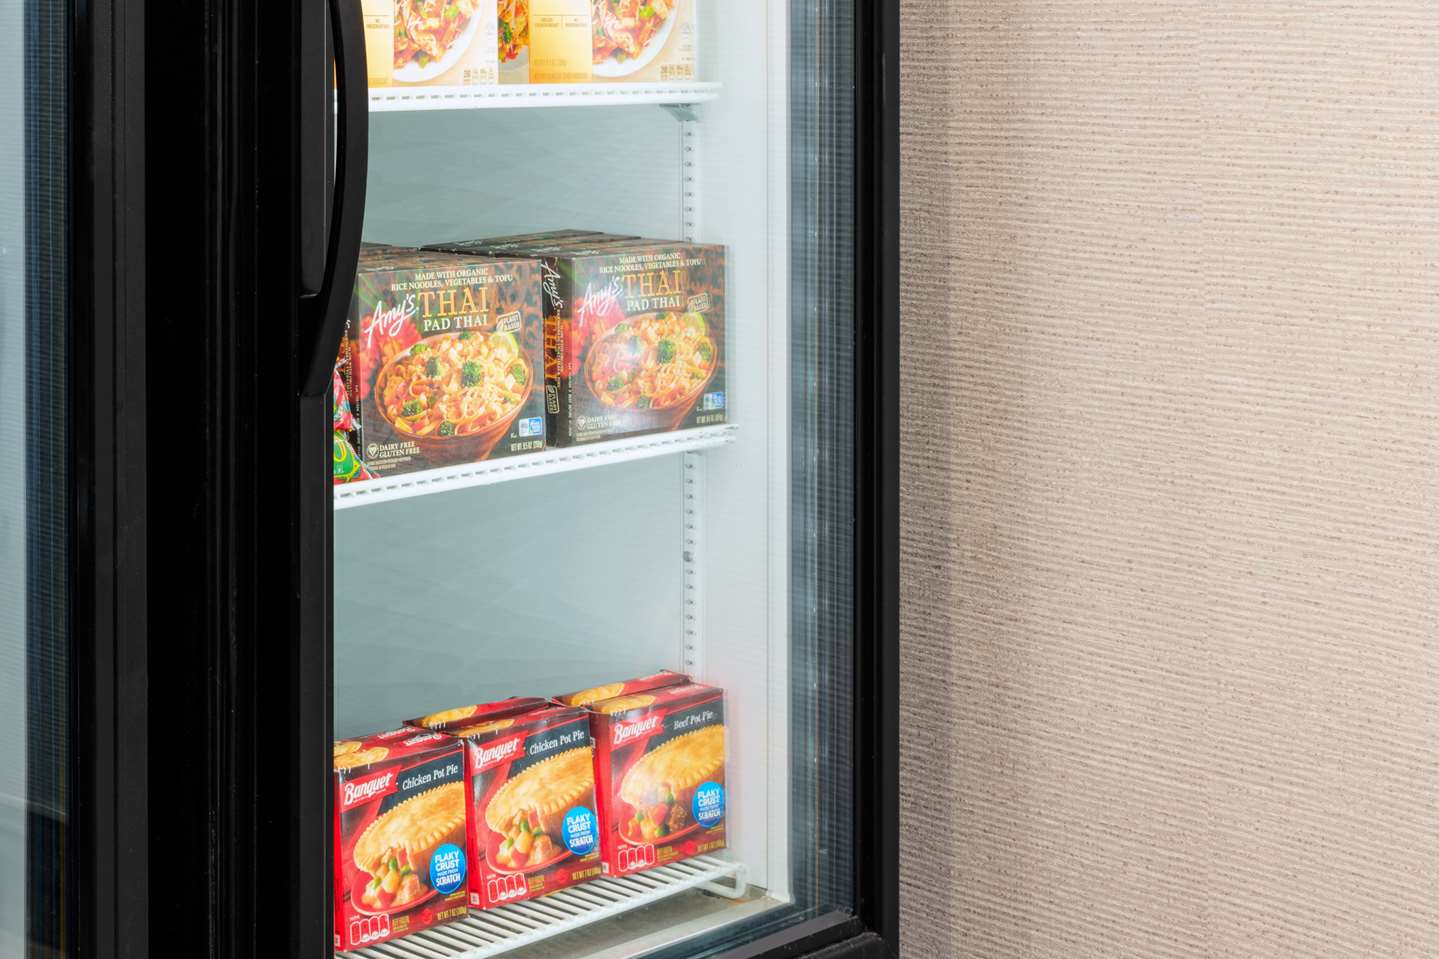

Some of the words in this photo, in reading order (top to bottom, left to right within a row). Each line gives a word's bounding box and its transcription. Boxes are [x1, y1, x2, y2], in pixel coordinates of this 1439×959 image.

[618, 255, 637, 265] MADE
[637, 254, 655, 263] WITH
[655, 251, 681, 262] ORGANIC
[414, 271, 436, 281] MADE
[436, 270, 456, 280] WITH
[456, 267, 489, 279] ORGANIC
[599, 265, 614, 274] RICE
[391, 282, 408, 292] RICE
[445, 274, 488, 288] VEGETABLES
[495, 273, 514, 283] TOFU
[622, 269, 683, 299] THAI
[417, 286, 490, 319] THAI
[577, 274, 625, 328] Amy's
[626, 297, 650, 312] PAD
[652, 294, 681, 309] THAI
[364, 292, 419, 350] Amy's
[423, 317, 451, 332] PAD
[453, 314, 489, 330] THAI
[378, 442, 399, 452] DAIRY
[400, 441, 417, 450] FREE
[378, 448, 405, 459] GLUTEN
[405, 446, 421, 455] FREE
[613, 713, 660, 745] Banquet
[672, 716, 690, 731] Beef
[690, 714, 701, 727] Pot
[701, 711, 714, 724] Pie
[528, 738, 559, 757] Chicken
[559, 734, 572, 747] Pot
[572, 729, 585, 743] Pie
[473, 737, 521, 769] Banquet
[401, 772, 432, 791] Chicken
[433, 768, 445, 780] Pot
[446, 763, 459, 776] Pie
[343, 772, 394, 807] Banquet
[697, 788, 721, 800] FLAKY
[697, 796, 721, 808] CRUST
[566, 812, 590, 826] FLAKY
[567, 821, 591, 834] CRUST
[569, 834, 594, 848] SCRATCH
[434, 851, 460, 864] FLAKY
[434, 858, 460, 872] CRUST
[435, 873, 461, 887] SCRATCH
